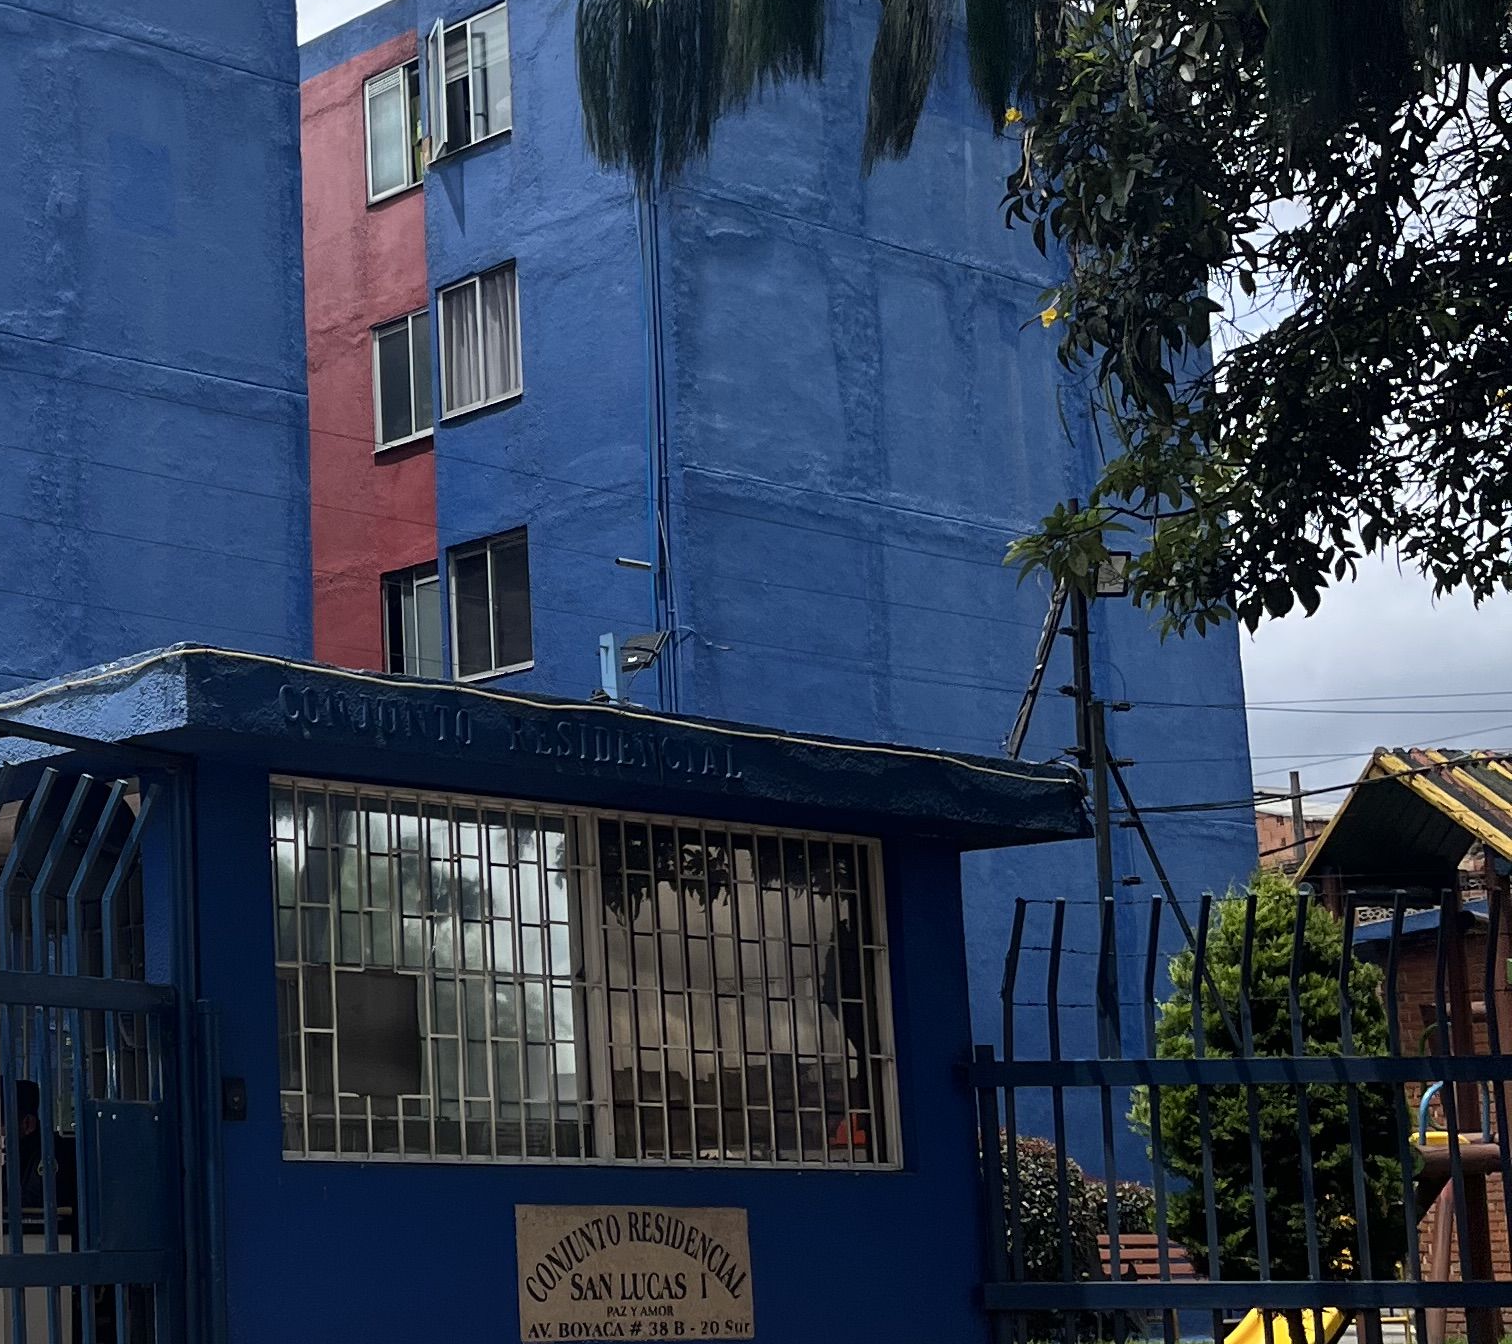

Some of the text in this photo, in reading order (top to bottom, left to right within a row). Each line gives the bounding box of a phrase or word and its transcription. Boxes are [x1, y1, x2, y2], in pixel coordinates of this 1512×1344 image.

[278, 683, 743, 779] CONJUNTO RESIDENCIAL
[525, 1211, 747, 1303] CONJUNTO RESIDENCIAL
[570, 1272, 708, 1302] SAN LUCAS I
[606, 1305, 675, 1317] PAZ Y AMOR
[527, 1322, 553, 1338] AV.
[558, 1321, 625, 1338] BOYACA
[629, 1321, 643, 1336] #
[648, 1321, 669, 1336] 38
[674, 1320, 686, 1336] B
[699, 1320, 720, 1335] 20
[723, 1318, 751, 1334] Sur
